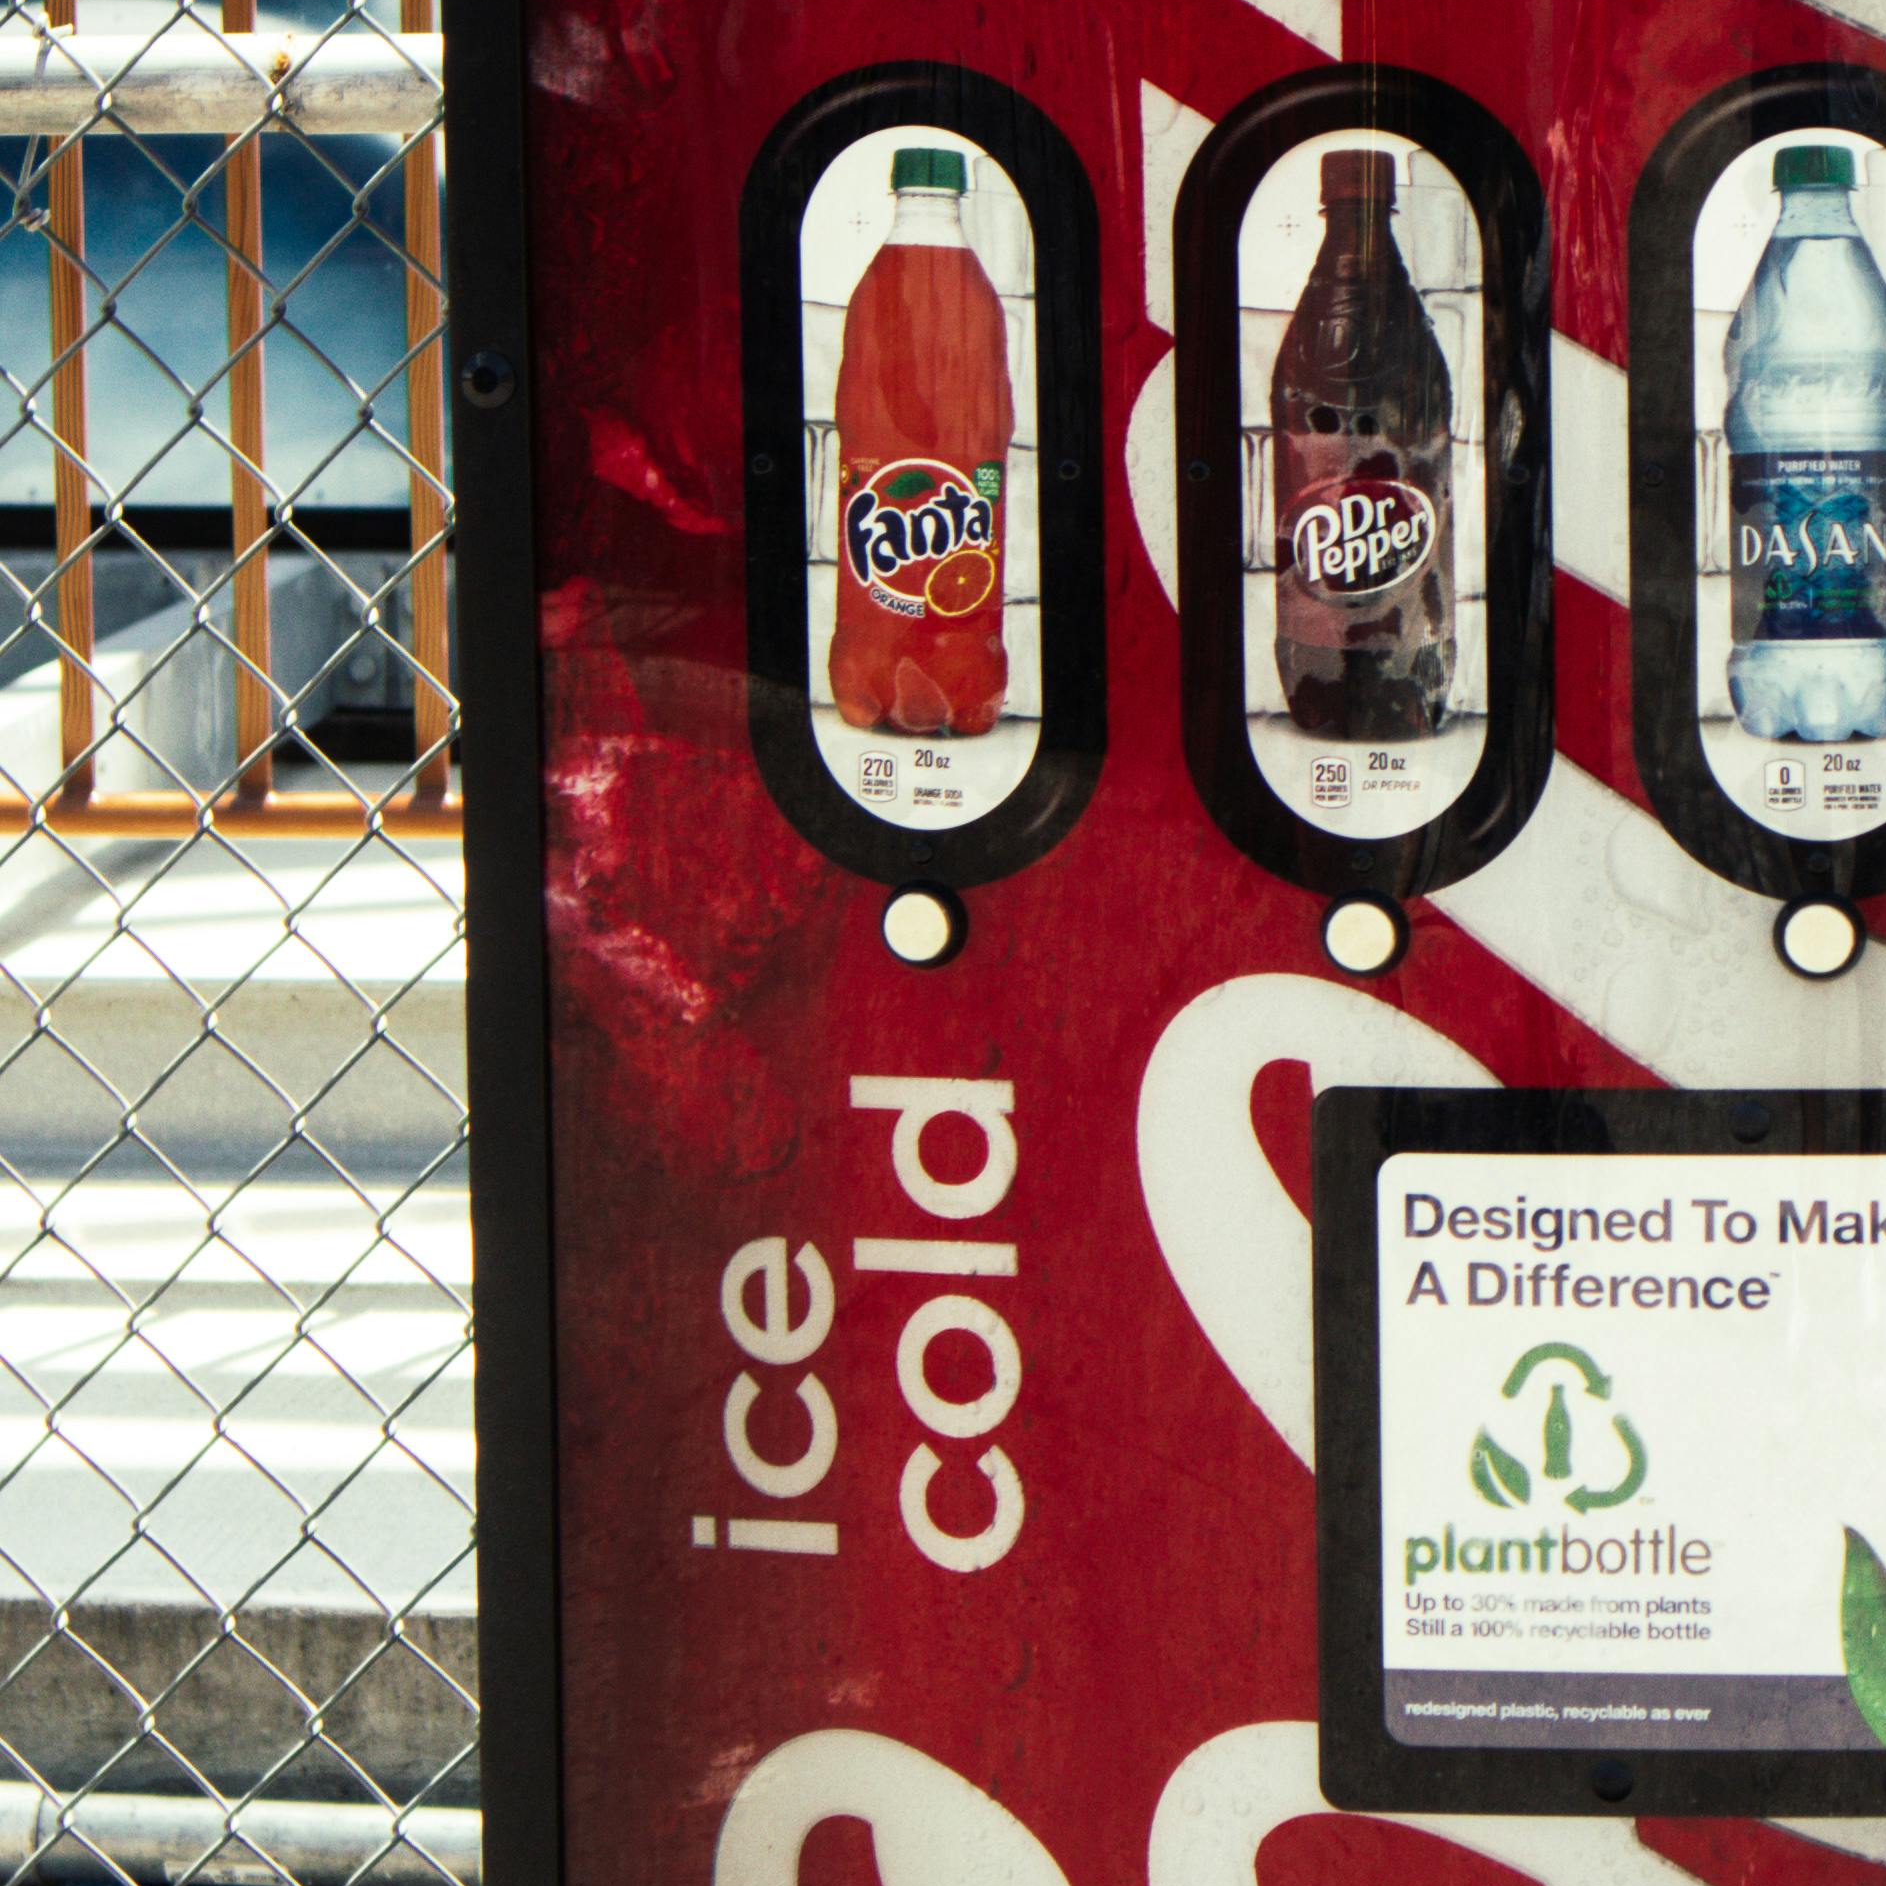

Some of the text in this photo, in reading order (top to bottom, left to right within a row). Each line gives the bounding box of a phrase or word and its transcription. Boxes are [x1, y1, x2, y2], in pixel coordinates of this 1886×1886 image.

[1778, 460, 1861, 472] PURIFIED WATER
[1340, 493, 1396, 541] Dr
[845, 481, 993, 587] Fanta
[1293, 504, 1427, 582] Pepper
[871, 588, 925, 617] ORANGE
[863, 758, 893, 777] 270
[914, 749, 951, 768] 20 oz
[1369, 752, 1405, 770] 20 oz
[1824, 754, 1861, 771] 20 oz
[1315, 764, 1346, 783] 250
[1362, 780, 1420, 791] DR PEPPER
[1780, 766, 1790, 785] 0
[1404, 1192, 1672, 1252] Designed
[1691, 1198, 1758, 1244] To
[1406, 1261, 1448, 1305] A
[850, 1075, 1025, 1574] cold
[692, 1236, 839, 1556] ice
[1405, 1523, 1712, 1586] plantbottle
[1406, 1593, 1436, 1615] Up
[1443, 1595, 1464, 1611] to
[1523, 1595, 1585, 1613] made
[1590, 1596, 1640, 1613] from
[1646, 1596, 1711, 1618] plants
[1406, 1619, 1711, 1644] Still a 100% recyclable bottle
[1405, 1700, 1711, 1723] redesigned plastic, recyclable as ever
